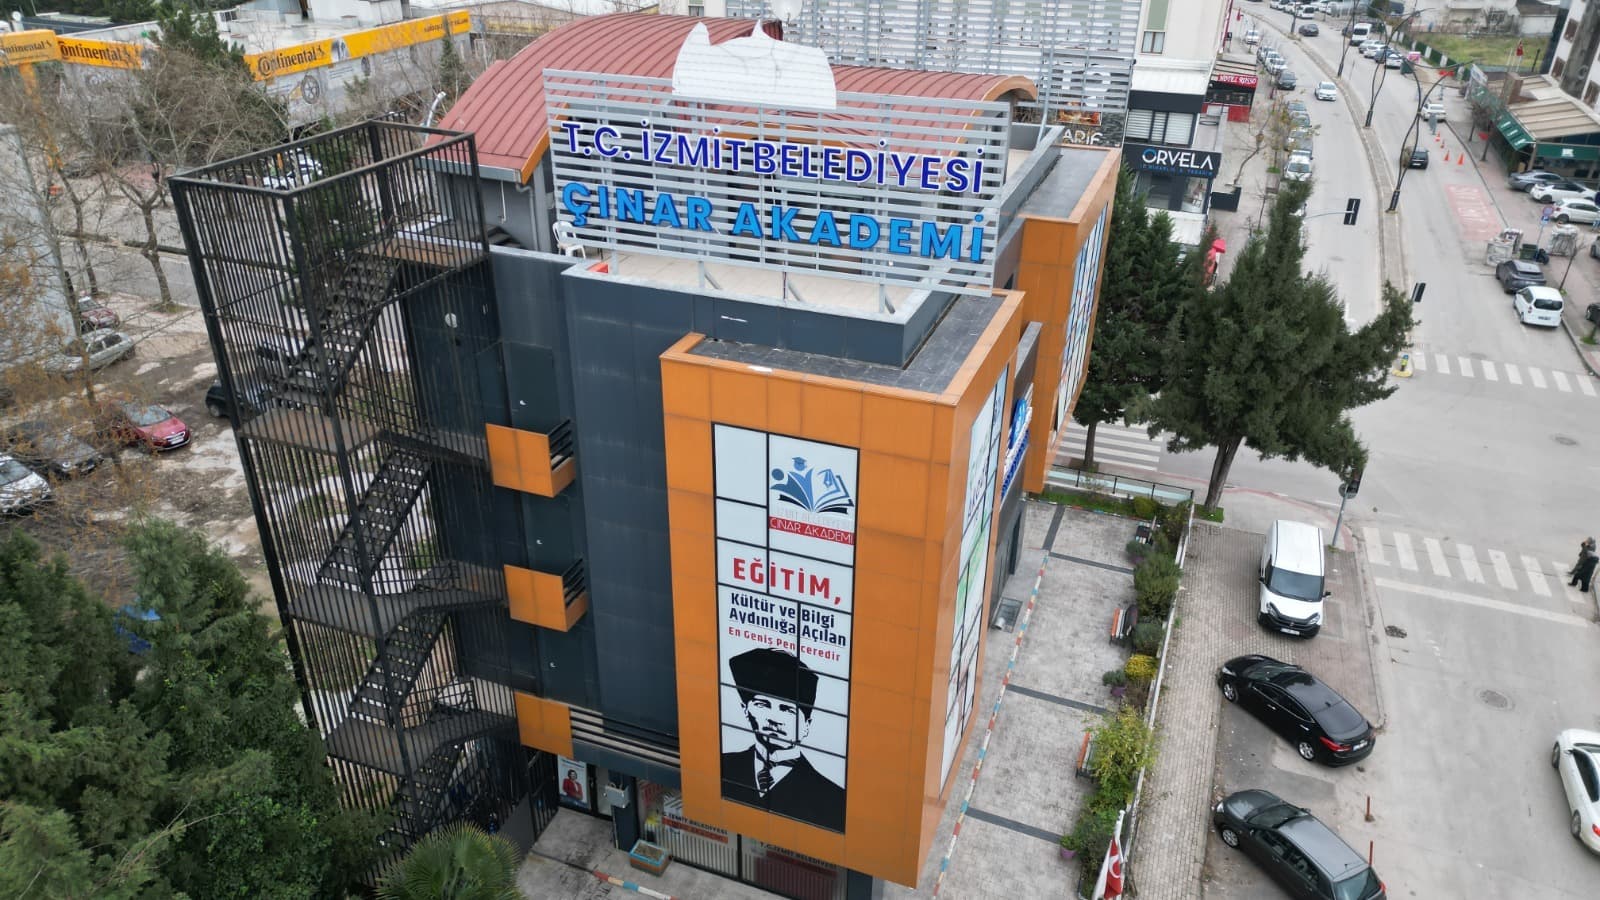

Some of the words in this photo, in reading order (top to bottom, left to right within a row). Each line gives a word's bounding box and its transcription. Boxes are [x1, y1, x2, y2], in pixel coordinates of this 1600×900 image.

[258, 46, 317, 77] Continental
[561, 122, 633, 161] T.C.
[1142, 148, 1213, 170] ORVELA
[562, 182, 715, 232] ÇINAR
[731, 203, 985, 263] AKADEMİ
[733, 557, 842, 606] EĞİTİM,
[729, 607, 797, 635] Aydınlığa
[802, 625, 847, 647] Açılan
[731, 592, 775, 614] Kültür
[779, 605, 797, 619] ve
[801, 608, 835, 629] Bilgi
[728, 626, 741, 637] En
[743, 630, 774, 646] Geniş
